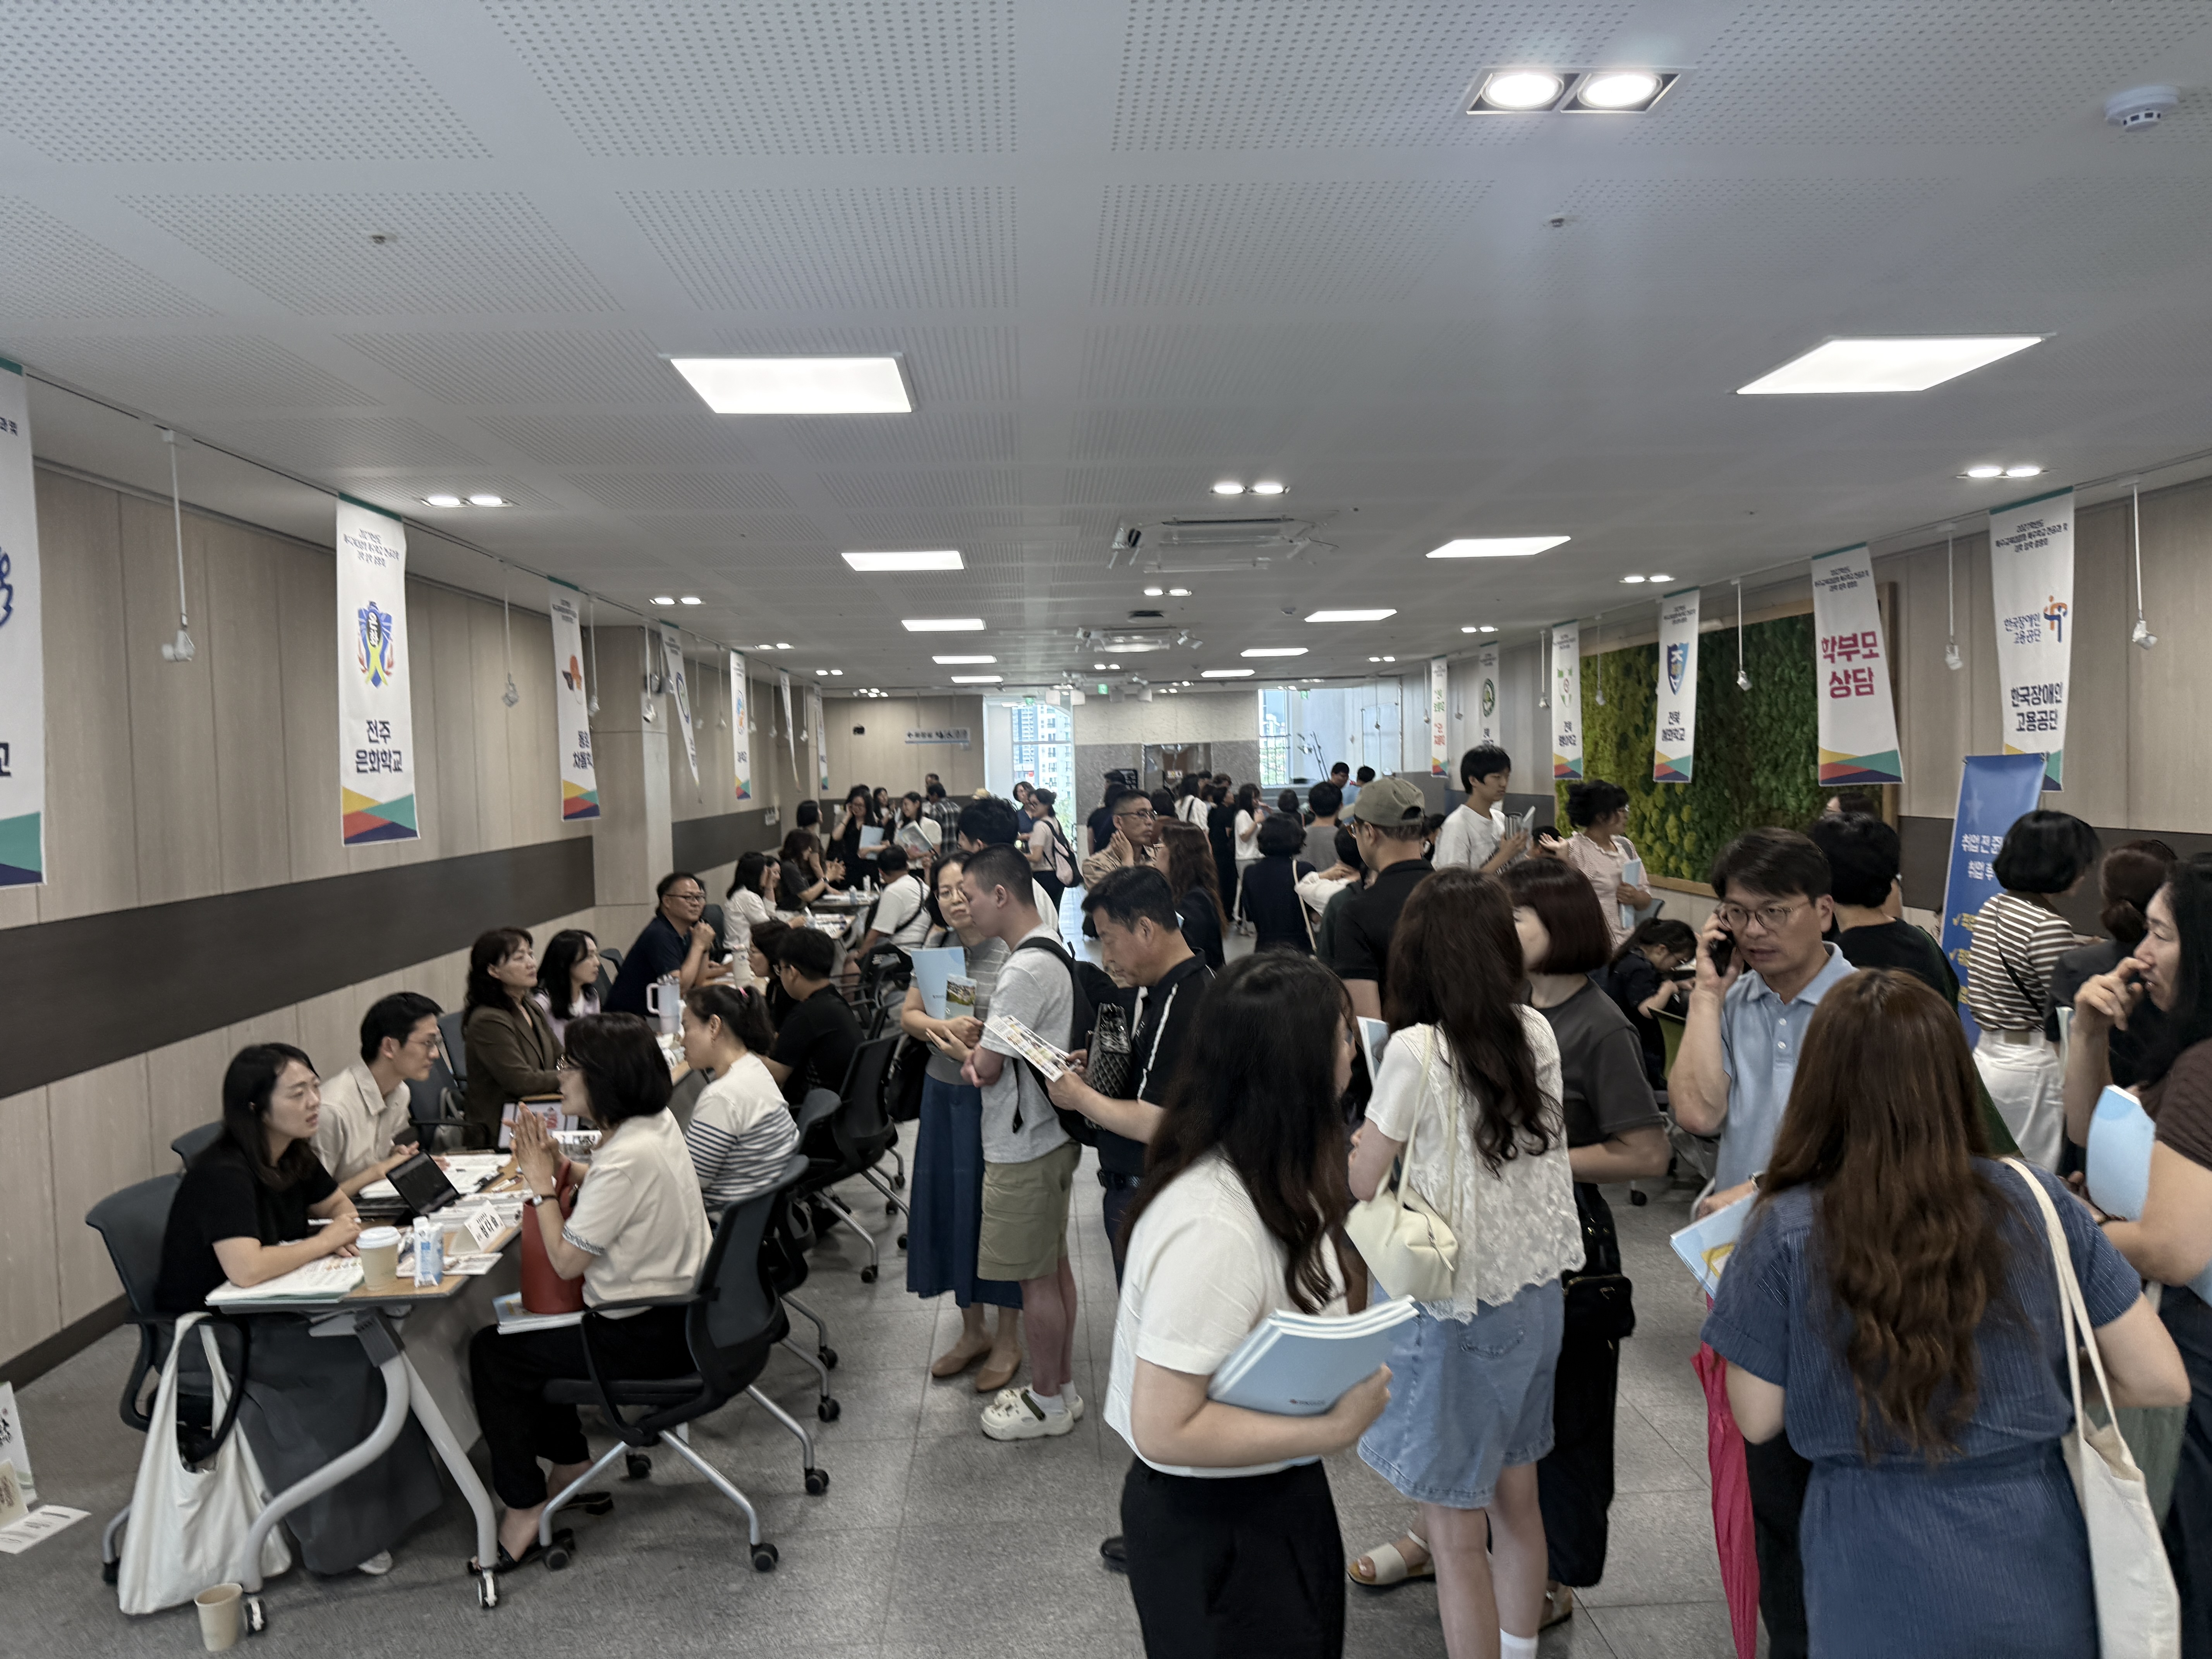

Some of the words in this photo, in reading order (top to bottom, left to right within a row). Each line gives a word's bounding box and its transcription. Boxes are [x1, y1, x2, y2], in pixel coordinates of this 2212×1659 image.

[2004, 612, 2041, 632] 한국장애인
[1821, 631, 1880, 664] 학부모
[1829, 666, 1875, 699] 상담
[2011, 682, 2063, 707] 한국장애인
[366, 719, 392, 744] 전주
[2016, 709, 2058, 732] 고용공단
[355, 749, 403, 773] 은화학교
[1961, 833, 1980, 853] 취업
[1968, 860, 1985, 880] 취업
